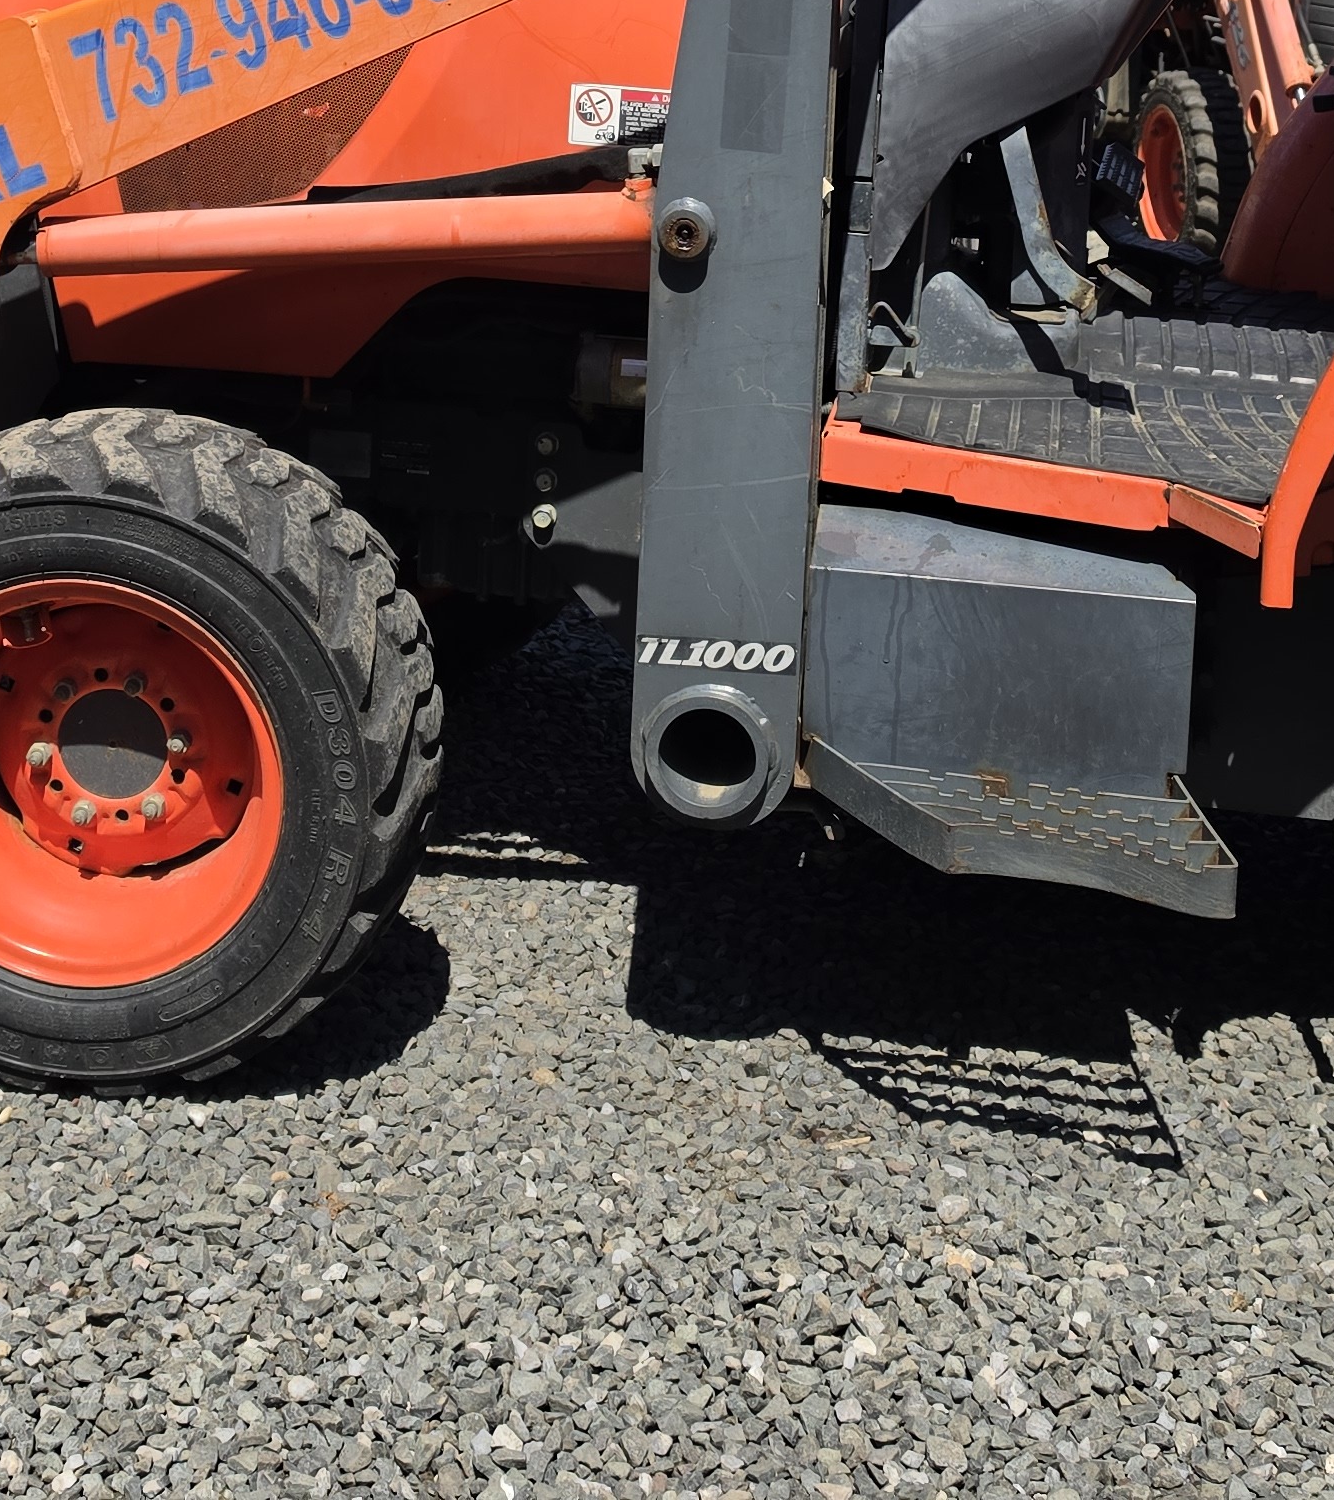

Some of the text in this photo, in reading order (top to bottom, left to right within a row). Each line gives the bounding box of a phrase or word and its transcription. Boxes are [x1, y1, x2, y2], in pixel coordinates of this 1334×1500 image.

[637, 636, 796, 673] TL1000
[300, 688, 358, 943] D304 R-4
